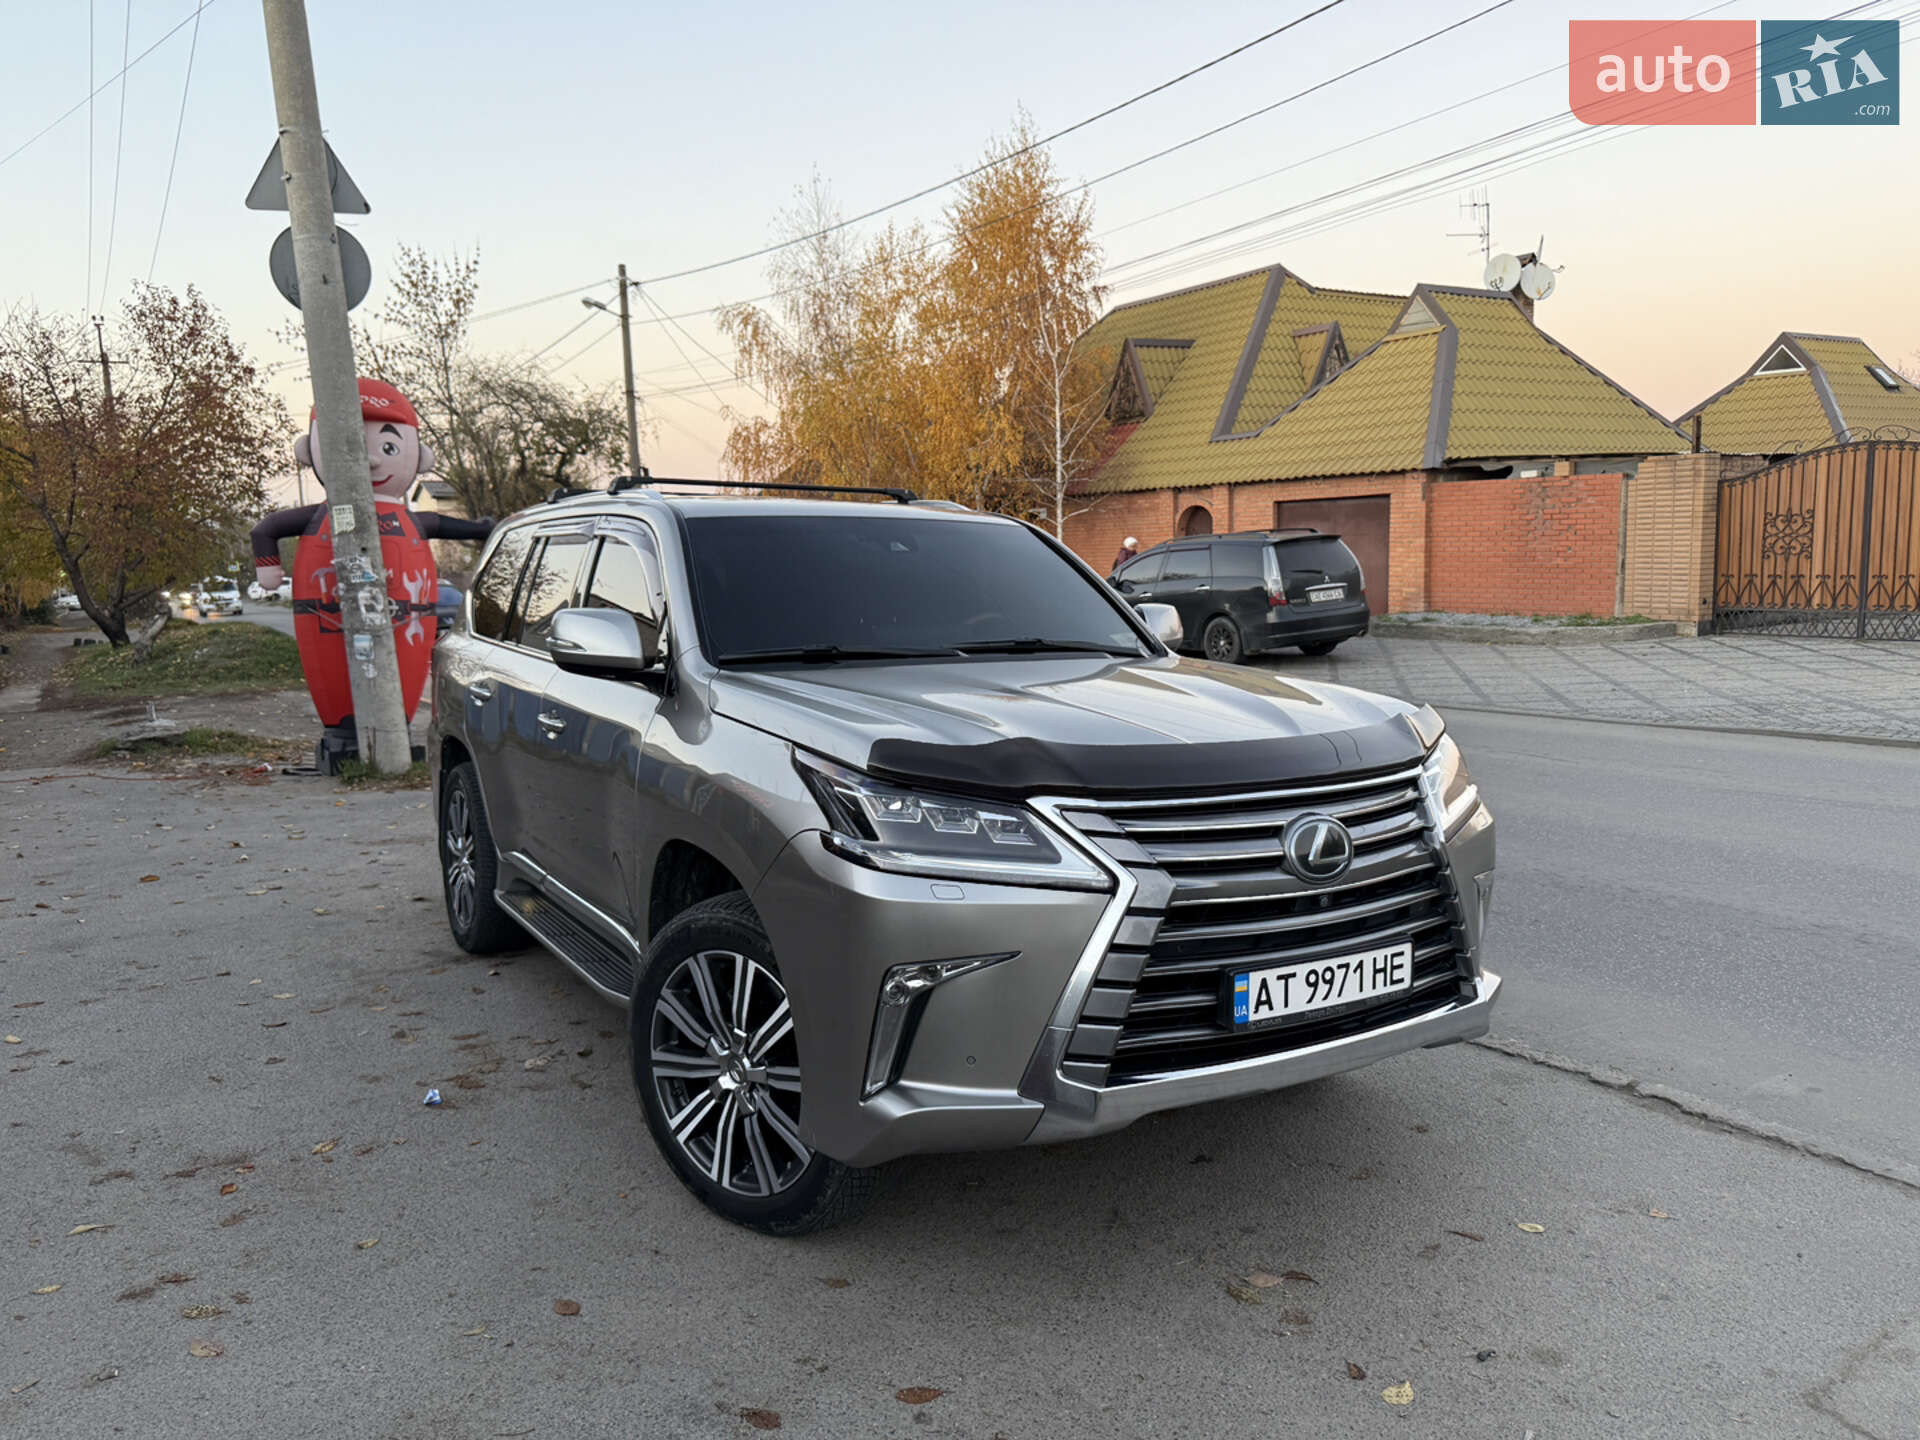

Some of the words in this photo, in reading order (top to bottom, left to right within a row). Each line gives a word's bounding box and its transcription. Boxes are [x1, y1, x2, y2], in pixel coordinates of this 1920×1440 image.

[1253, 971, 1297, 1014] AT
[1305, 959, 1364, 1004] 9971
[1372, 950, 1405, 990] HE
[1234, 1004, 1248, 1017] UA
